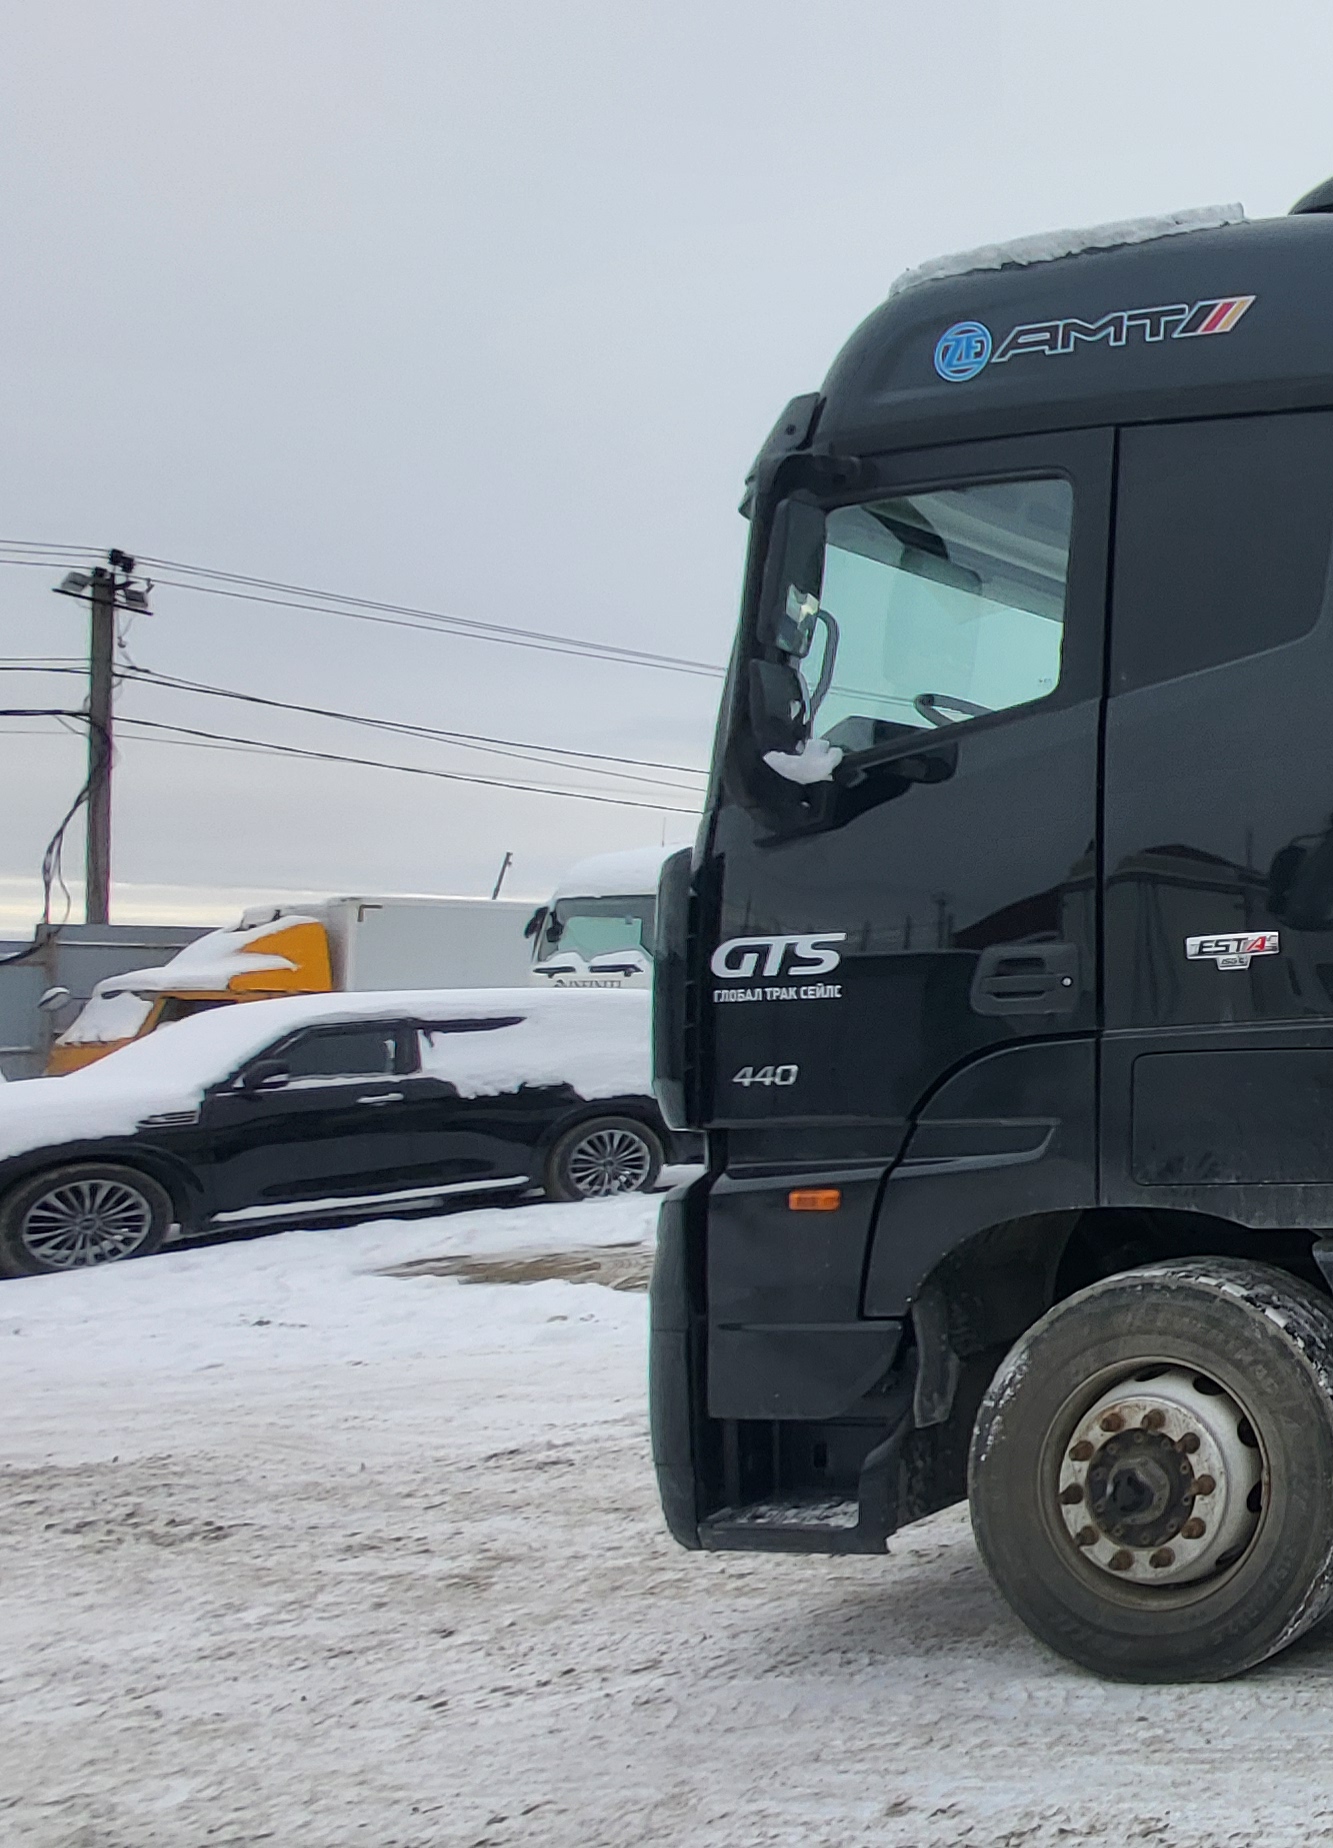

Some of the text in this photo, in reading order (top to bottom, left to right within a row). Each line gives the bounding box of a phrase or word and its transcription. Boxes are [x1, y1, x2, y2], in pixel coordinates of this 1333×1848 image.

[941, 304, 1188, 374] ZF AMT
[711, 932, 846, 978] GTS
[713, 983, 842, 1003] ГЛОБАЛ ТРАК СЕЙЛС
[732, 1064, 799, 1086] 440
